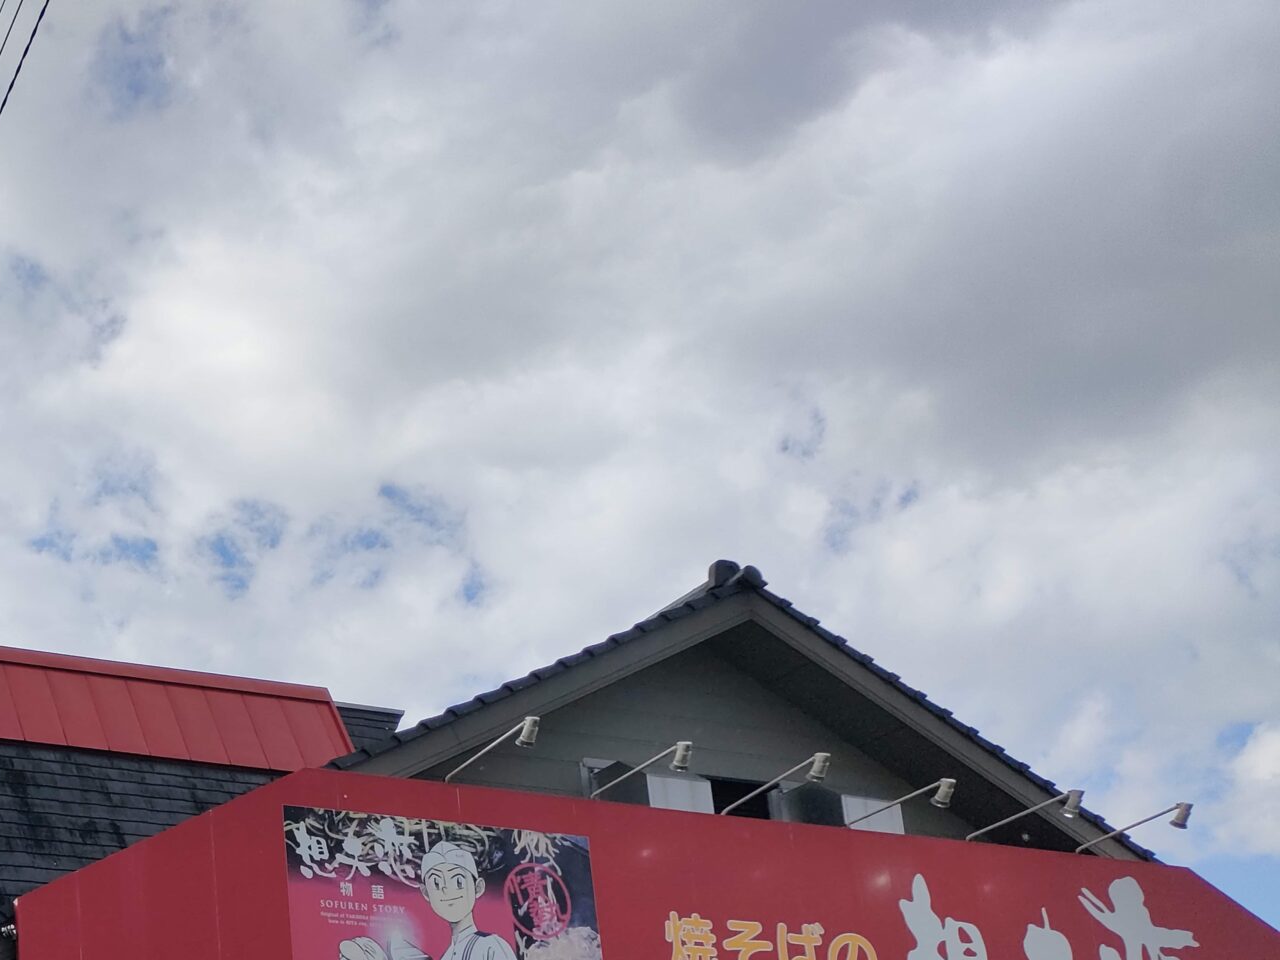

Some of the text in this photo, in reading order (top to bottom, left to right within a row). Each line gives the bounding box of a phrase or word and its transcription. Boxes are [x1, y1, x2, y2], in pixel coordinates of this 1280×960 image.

[340, 881, 384, 900] 物語
[320, 900, 406, 914] SOFUREN STORY
